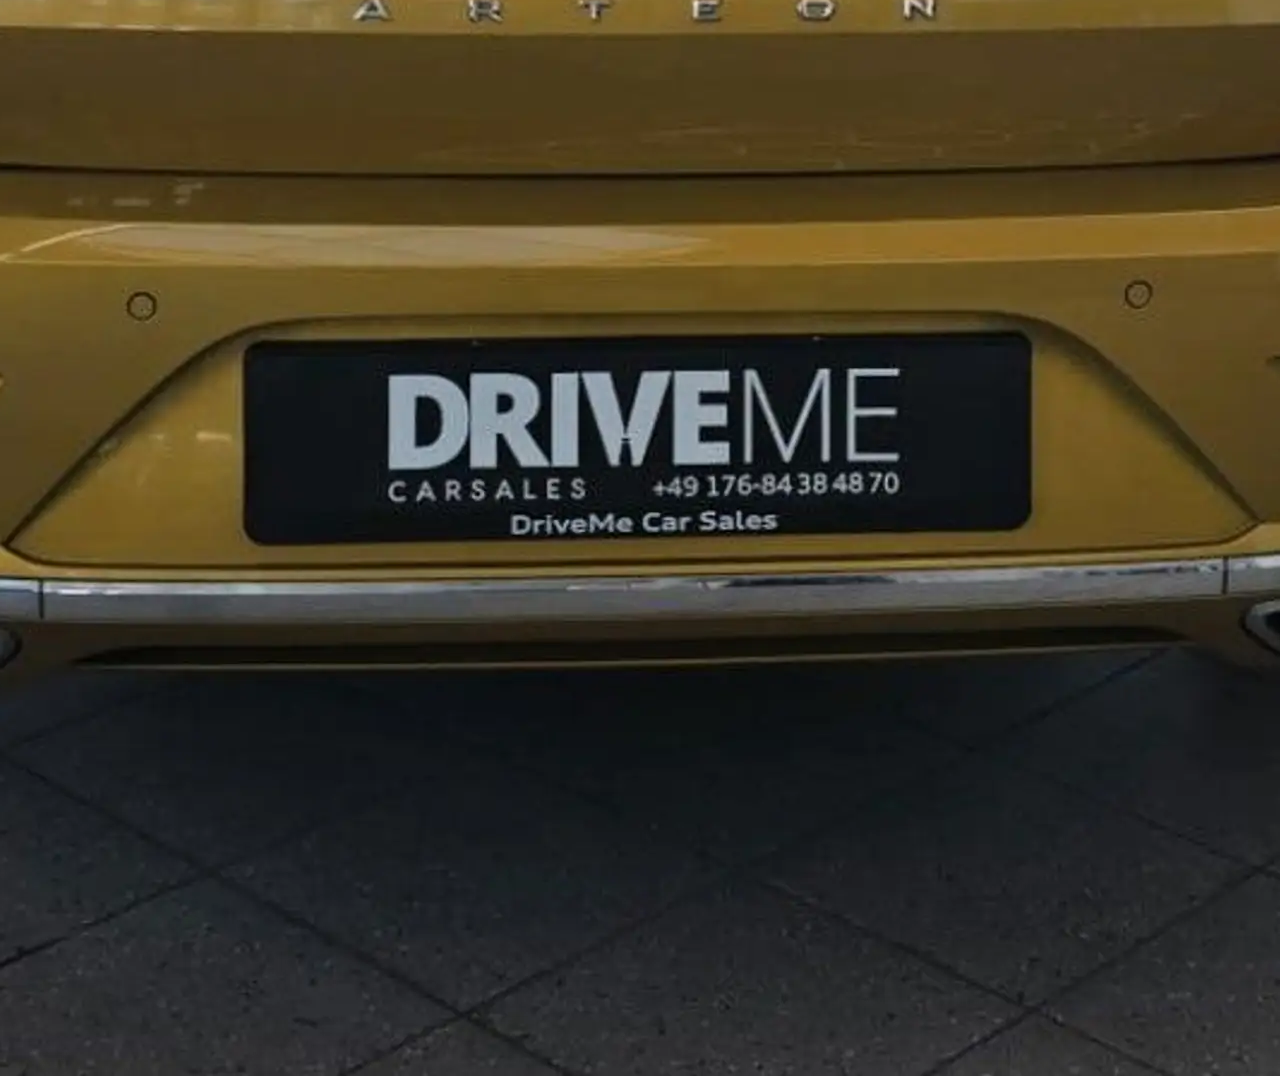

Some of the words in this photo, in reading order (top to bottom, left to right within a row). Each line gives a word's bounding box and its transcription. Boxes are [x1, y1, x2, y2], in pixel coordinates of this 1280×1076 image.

[387, 367, 901, 471] DRIVEME
[652, 476, 699, 499] +49
[510, 513, 635, 536] DriveMe
[641, 512, 694, 533] Car
[698, 509, 779, 532] Sales
